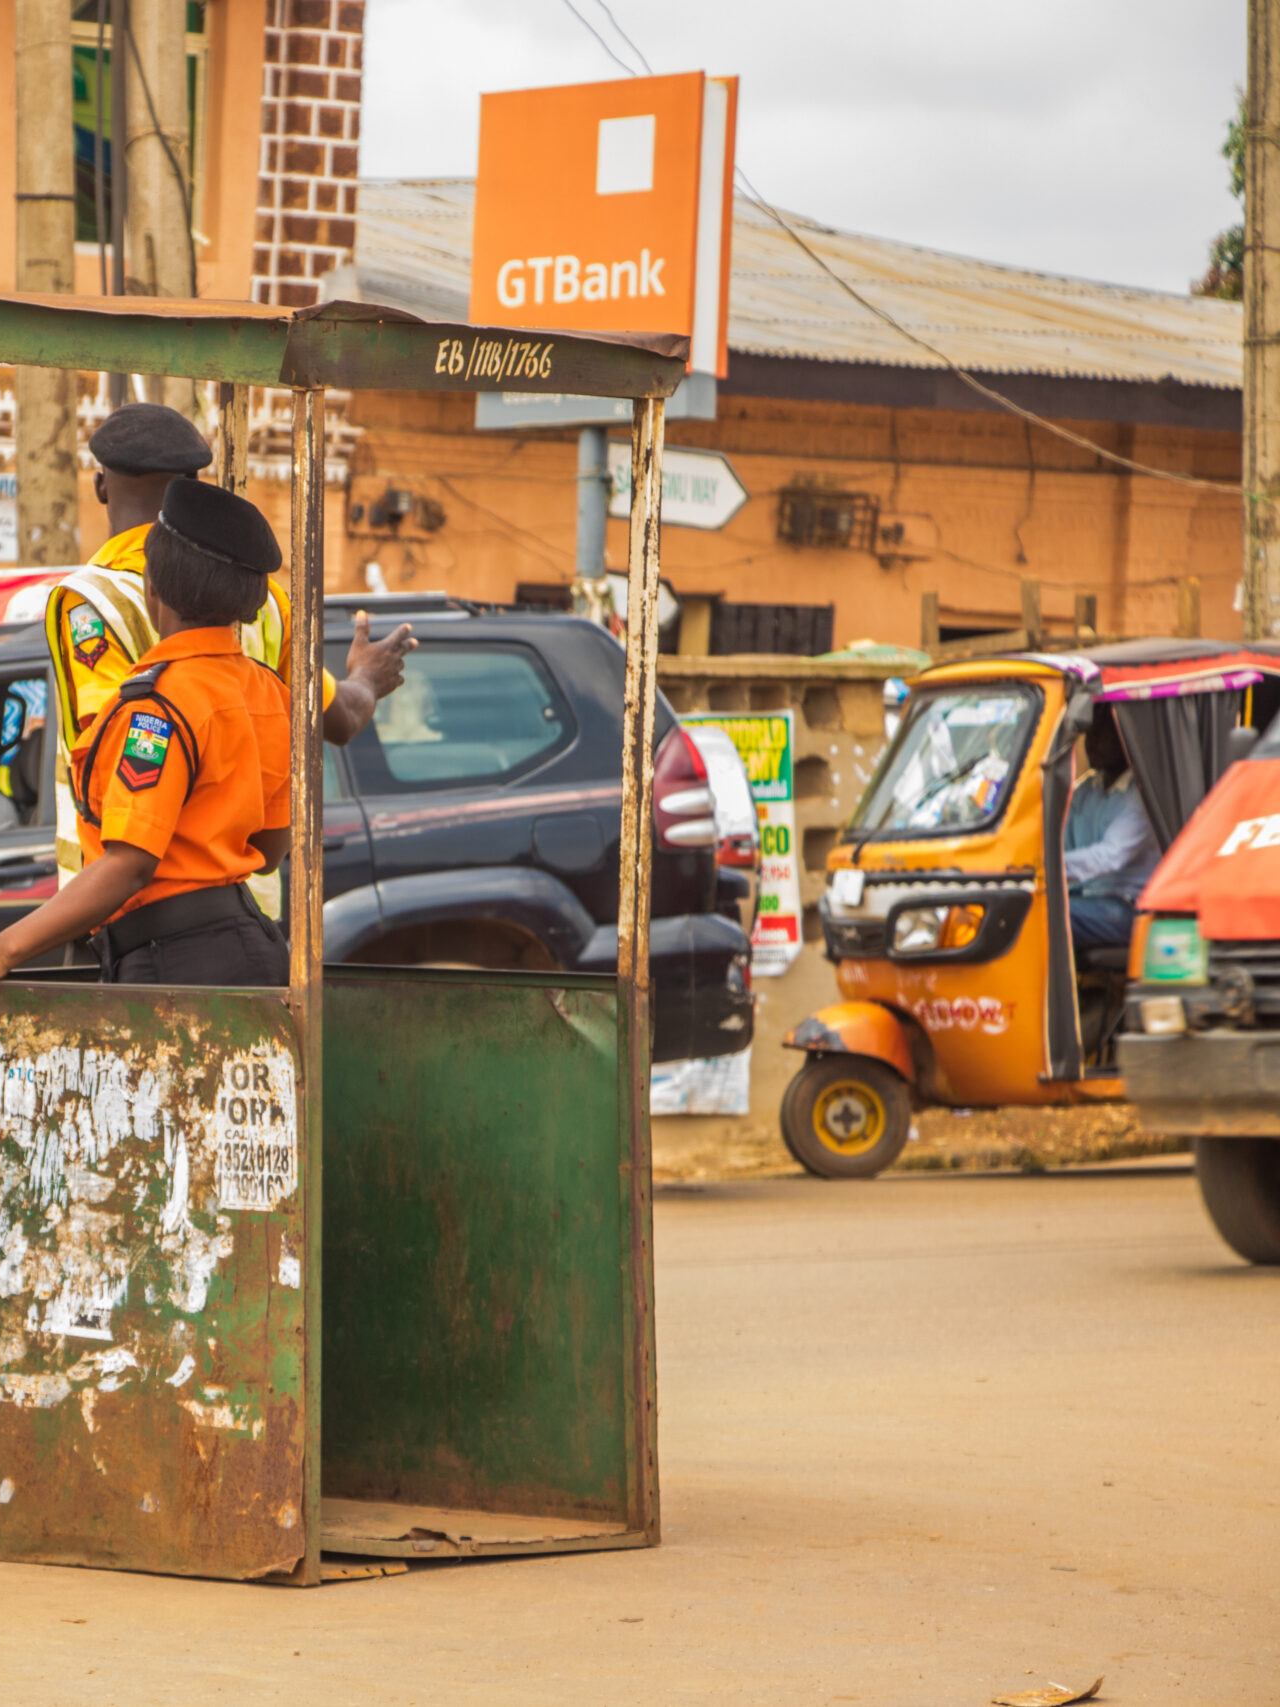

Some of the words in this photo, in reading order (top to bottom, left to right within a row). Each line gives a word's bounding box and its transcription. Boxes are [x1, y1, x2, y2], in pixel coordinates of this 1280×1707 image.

[497, 249, 666, 308] GTBank
[135, 713, 168, 730] NIGERIA
[137, 721, 161, 733] POLICE
